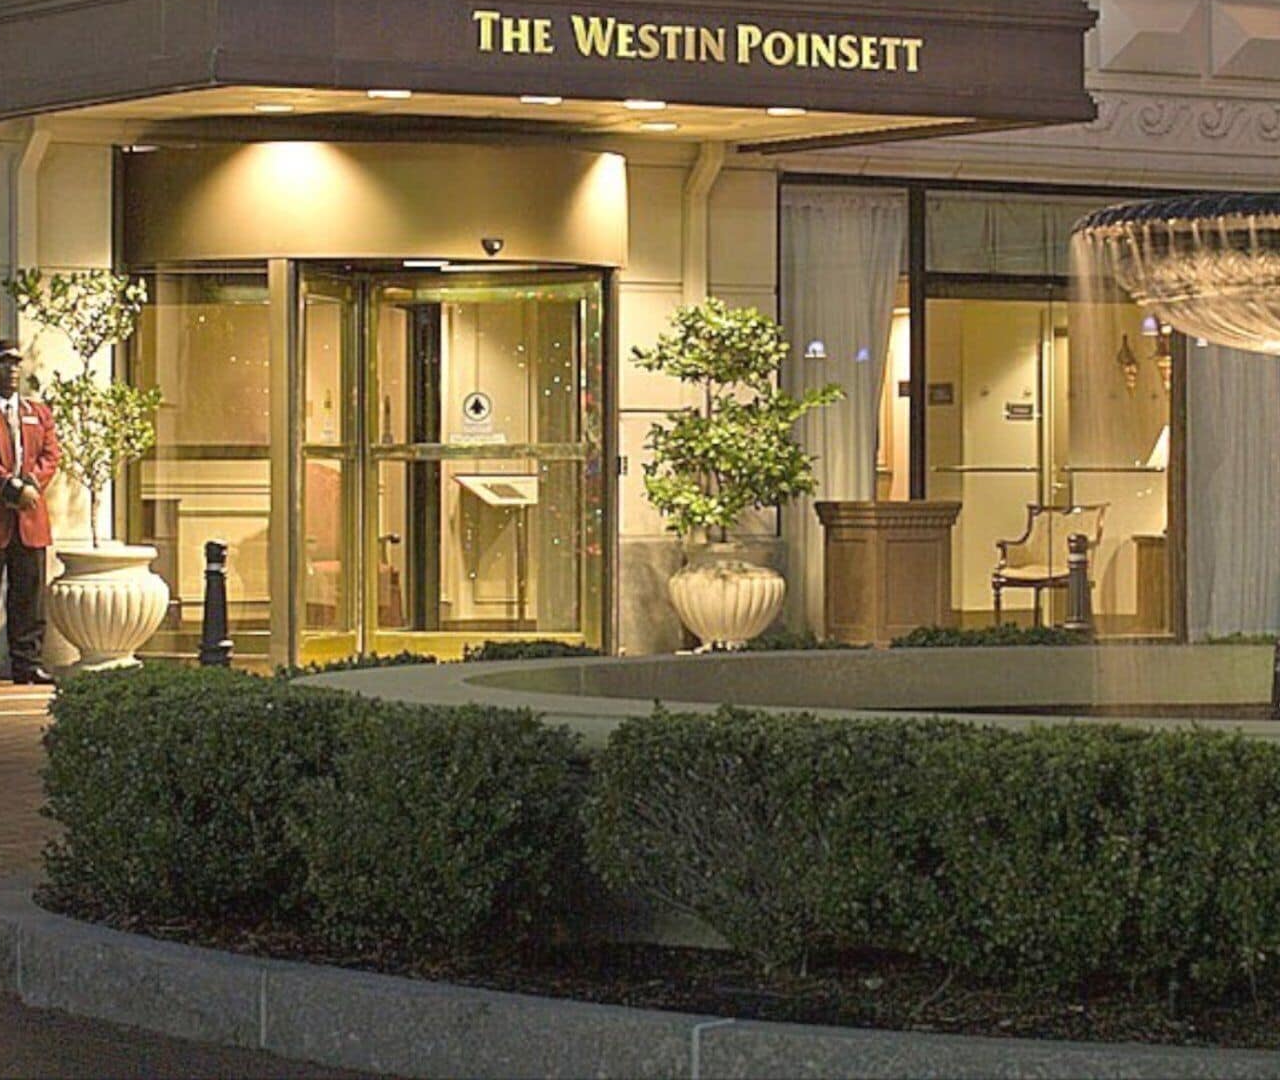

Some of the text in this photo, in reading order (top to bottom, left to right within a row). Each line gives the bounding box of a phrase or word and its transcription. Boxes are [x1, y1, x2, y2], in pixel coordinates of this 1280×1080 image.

[473, 9, 923, 73] THE WESTIN POINSETT
